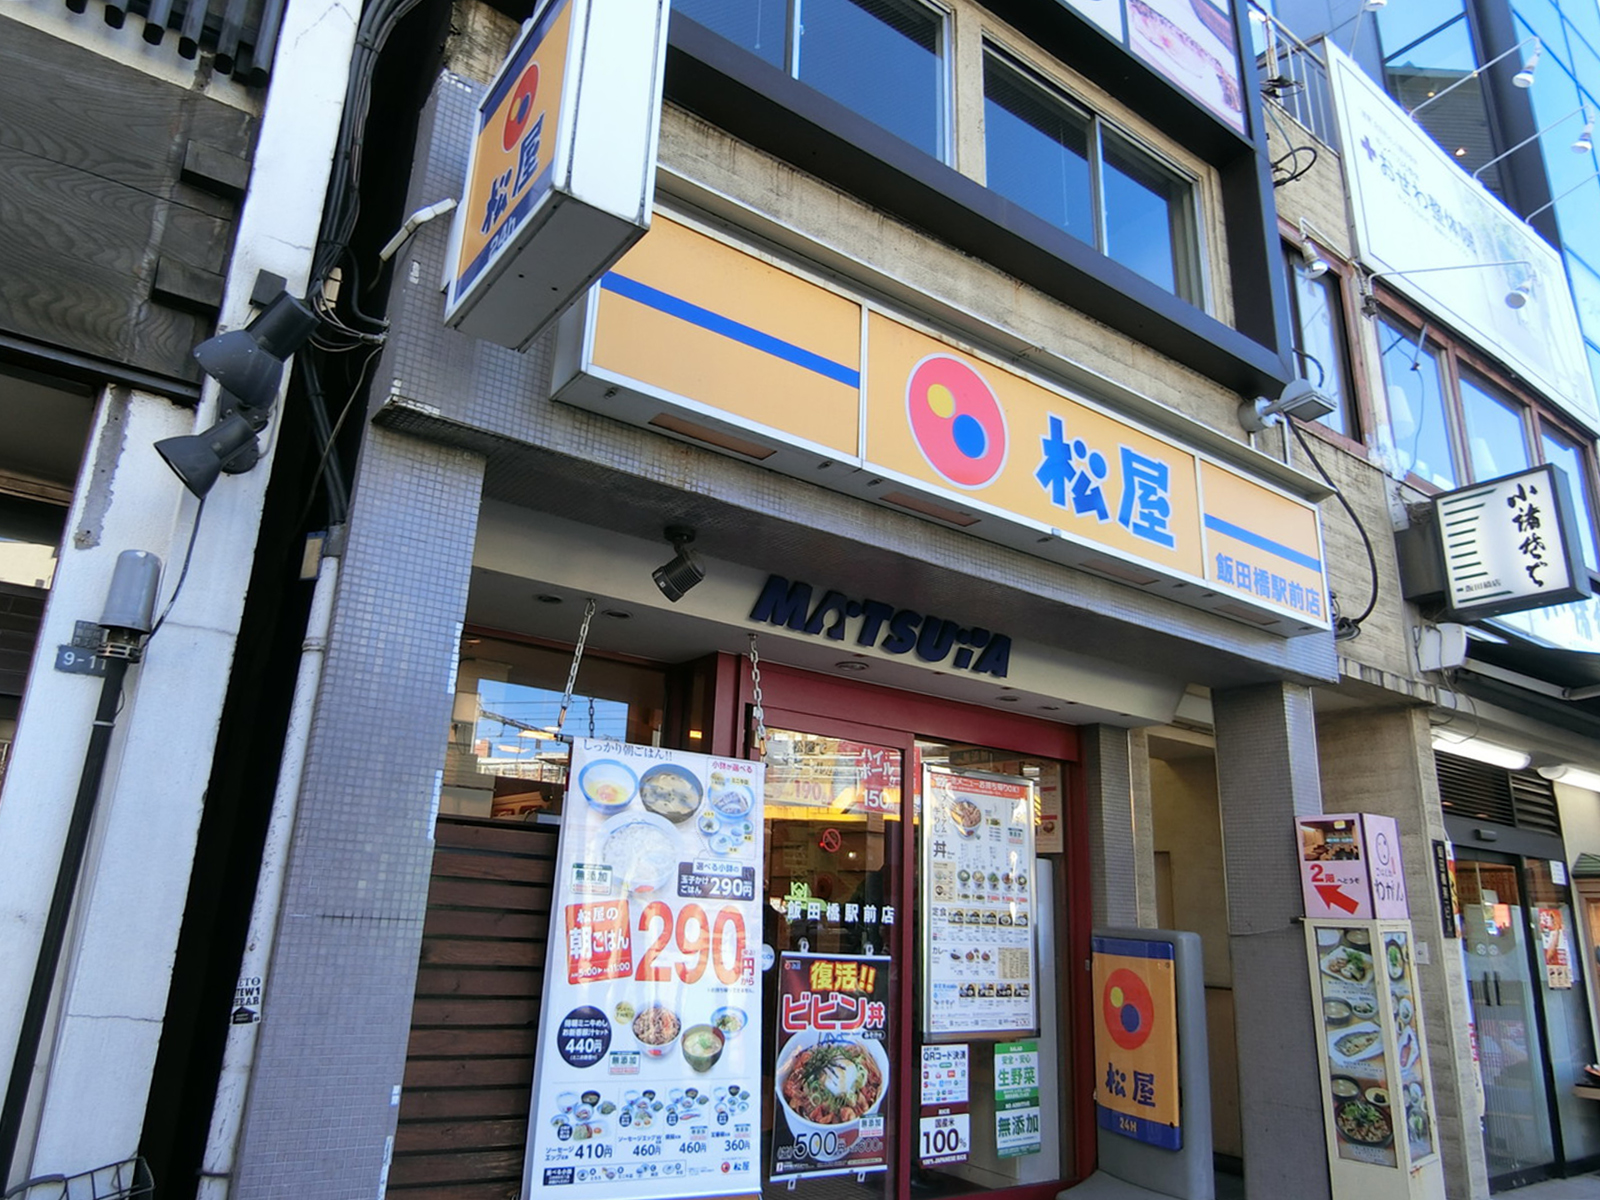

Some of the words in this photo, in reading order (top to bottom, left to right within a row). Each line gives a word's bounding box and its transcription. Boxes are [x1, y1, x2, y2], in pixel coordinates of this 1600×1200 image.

[481, 111, 546, 236] 松屋
[1033, 412, 1176, 550] 松屋
[1215, 551, 1321, 617] 飯田橋駅前店
[582, 738, 673, 762] しっかり朝ごはん!!
[933, 840, 947, 859] 丼
[709, 876, 753, 898] 290円
[576, 906, 619, 925] 松屋の
[787, 900, 896, 925] 飯田橋駅前店
[569, 926, 629, 960] 朝ごはん
[809, 960, 877, 993] 復活!!
[782, 992, 885, 1032] ビビン丼
[565, 1037, 602, 1054] 440円
[998, 1066, 1036, 1087] 生野菜
[1105, 1061, 1156, 1108] 松屋
[934, 1117, 955, 1128] 国産米
[998, 1113, 1040, 1138] 無添加
[1119, 1116, 1138, 1133] 24H
[575, 1143, 613, 1159] 410円
[923, 1128, 967, 1155] 100%
